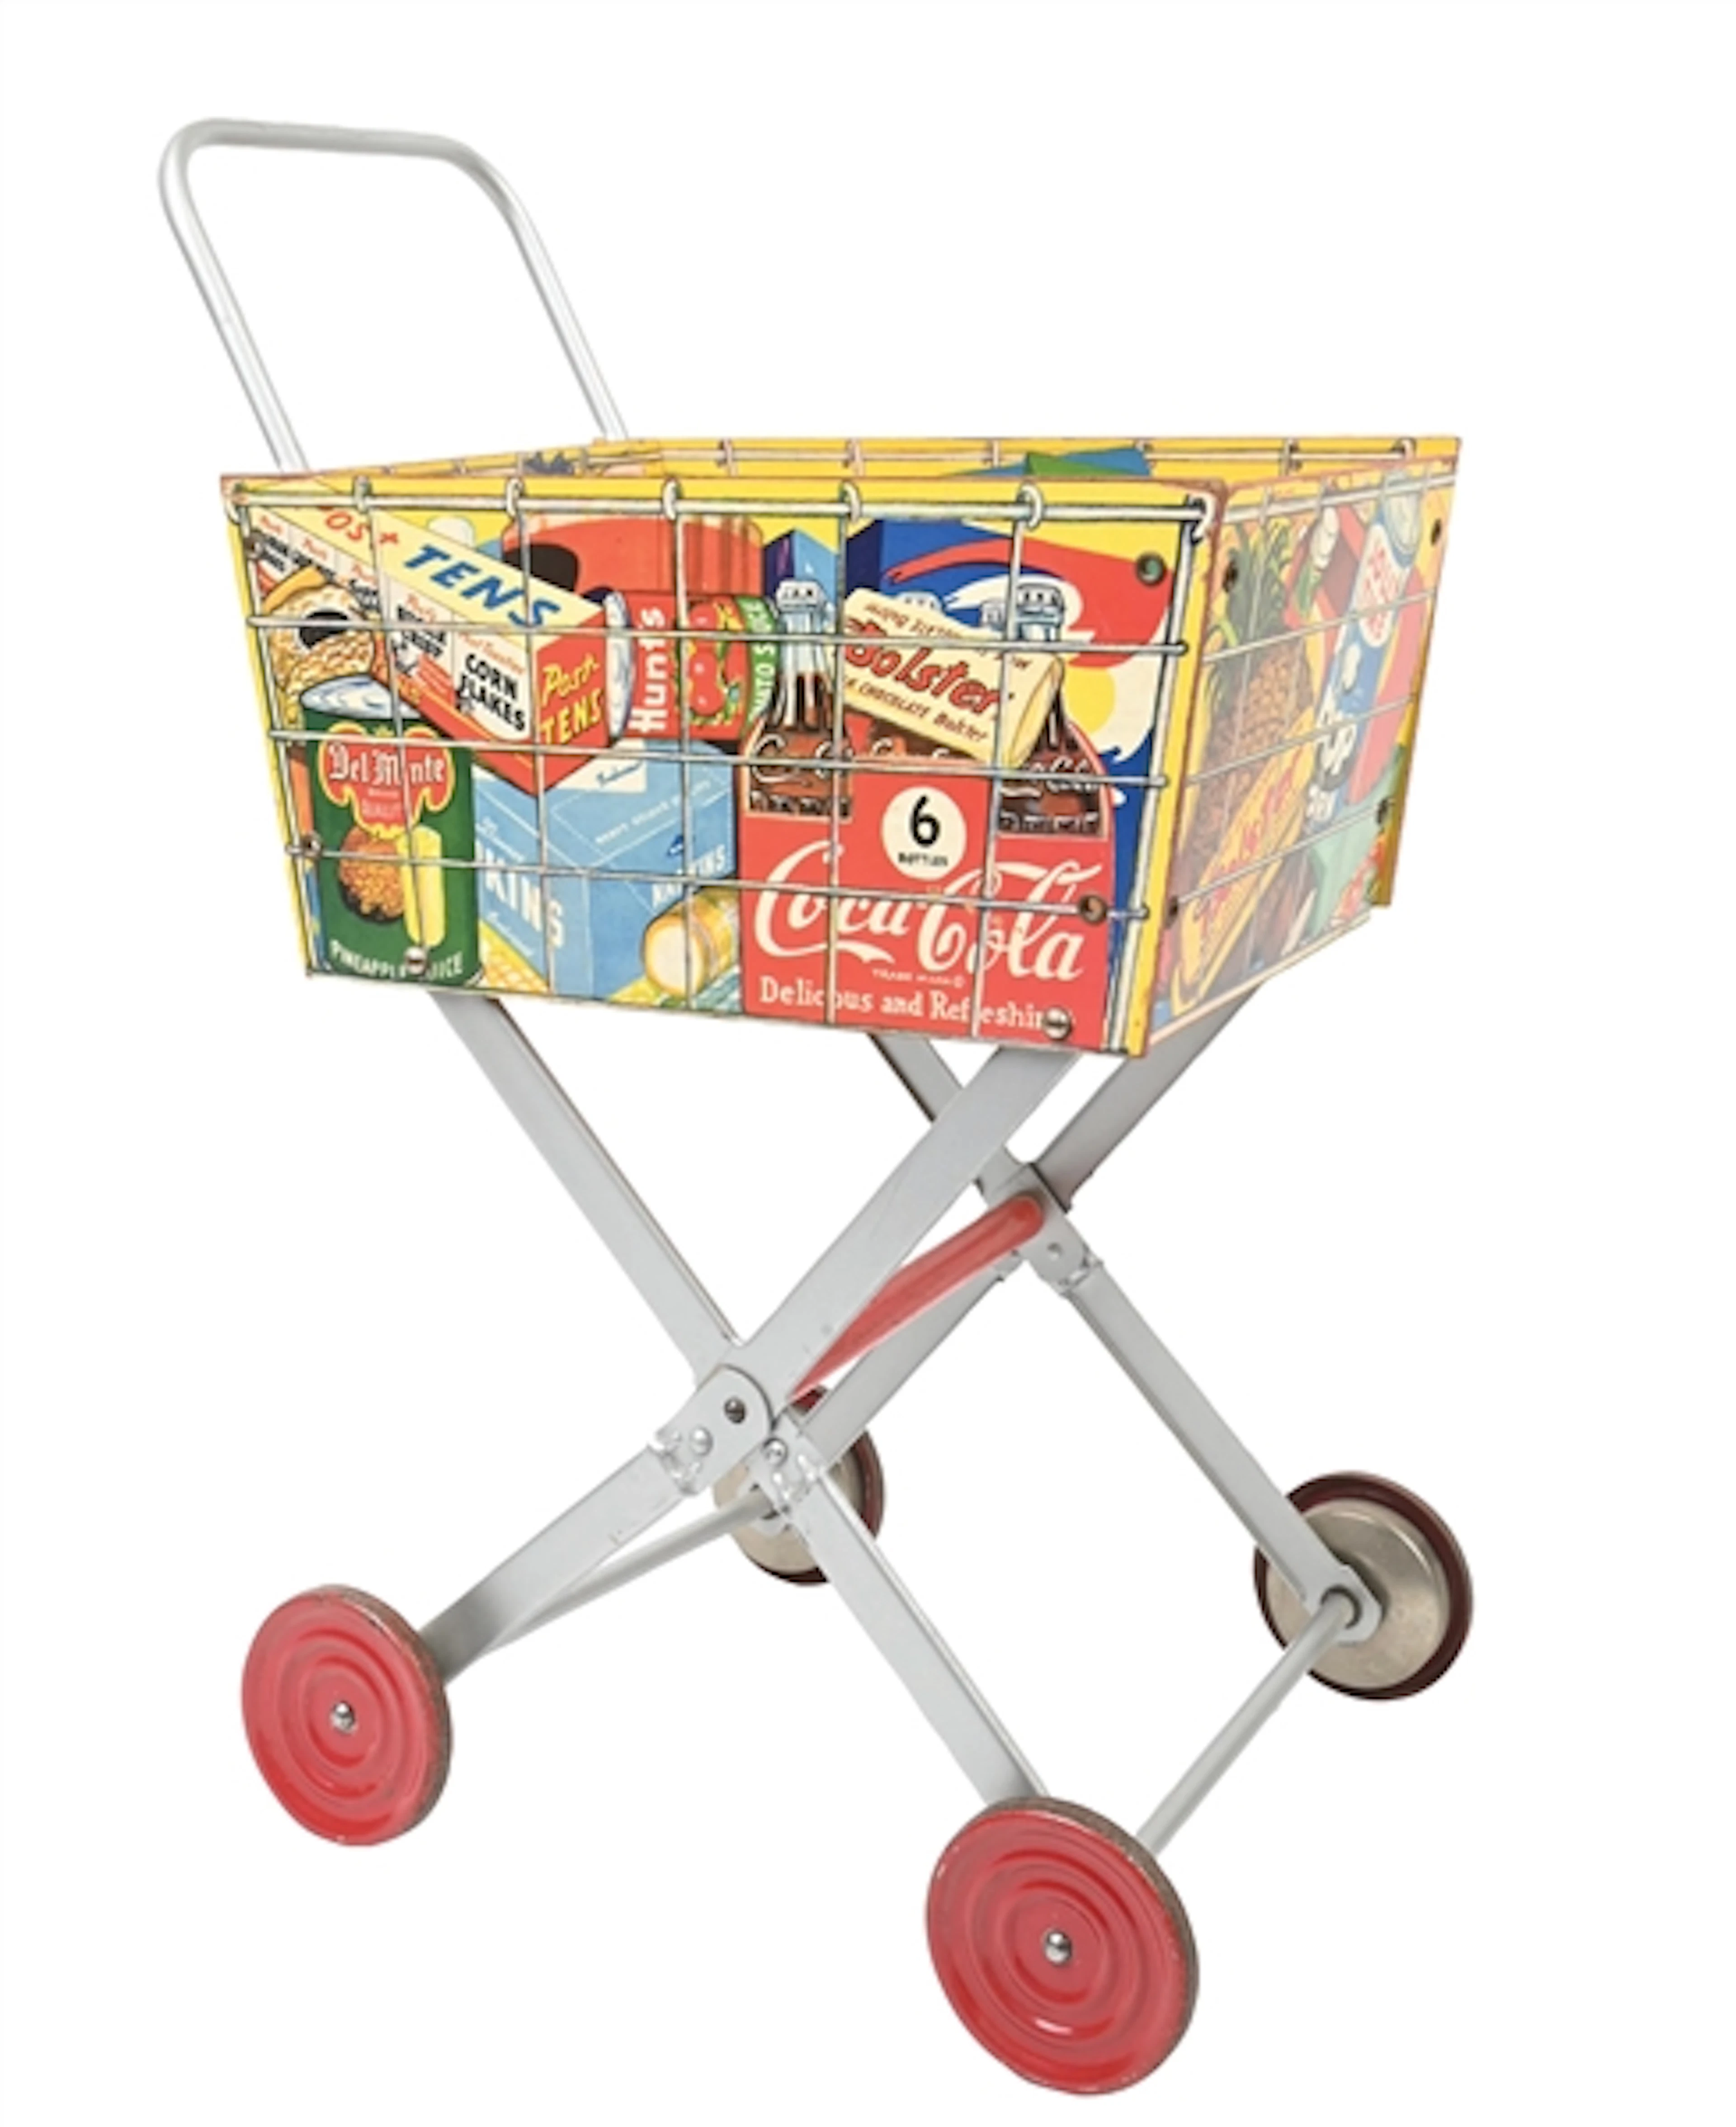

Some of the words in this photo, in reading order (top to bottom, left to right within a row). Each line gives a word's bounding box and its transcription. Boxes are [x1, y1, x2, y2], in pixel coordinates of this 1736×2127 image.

[403, 544, 561, 628] TENS
[456, 672, 525, 732] FLAKES
[465, 653, 519, 700] CORN
[541, 652, 601, 709] Post
[539, 687, 602, 745] TENS
[329, 742, 370, 783] Del
[371, 748, 449, 787] Mnte
[910, 795, 941, 848] 6
[328, 938, 408, 978] PINEAPPL
[881, 991, 924, 1017] and
